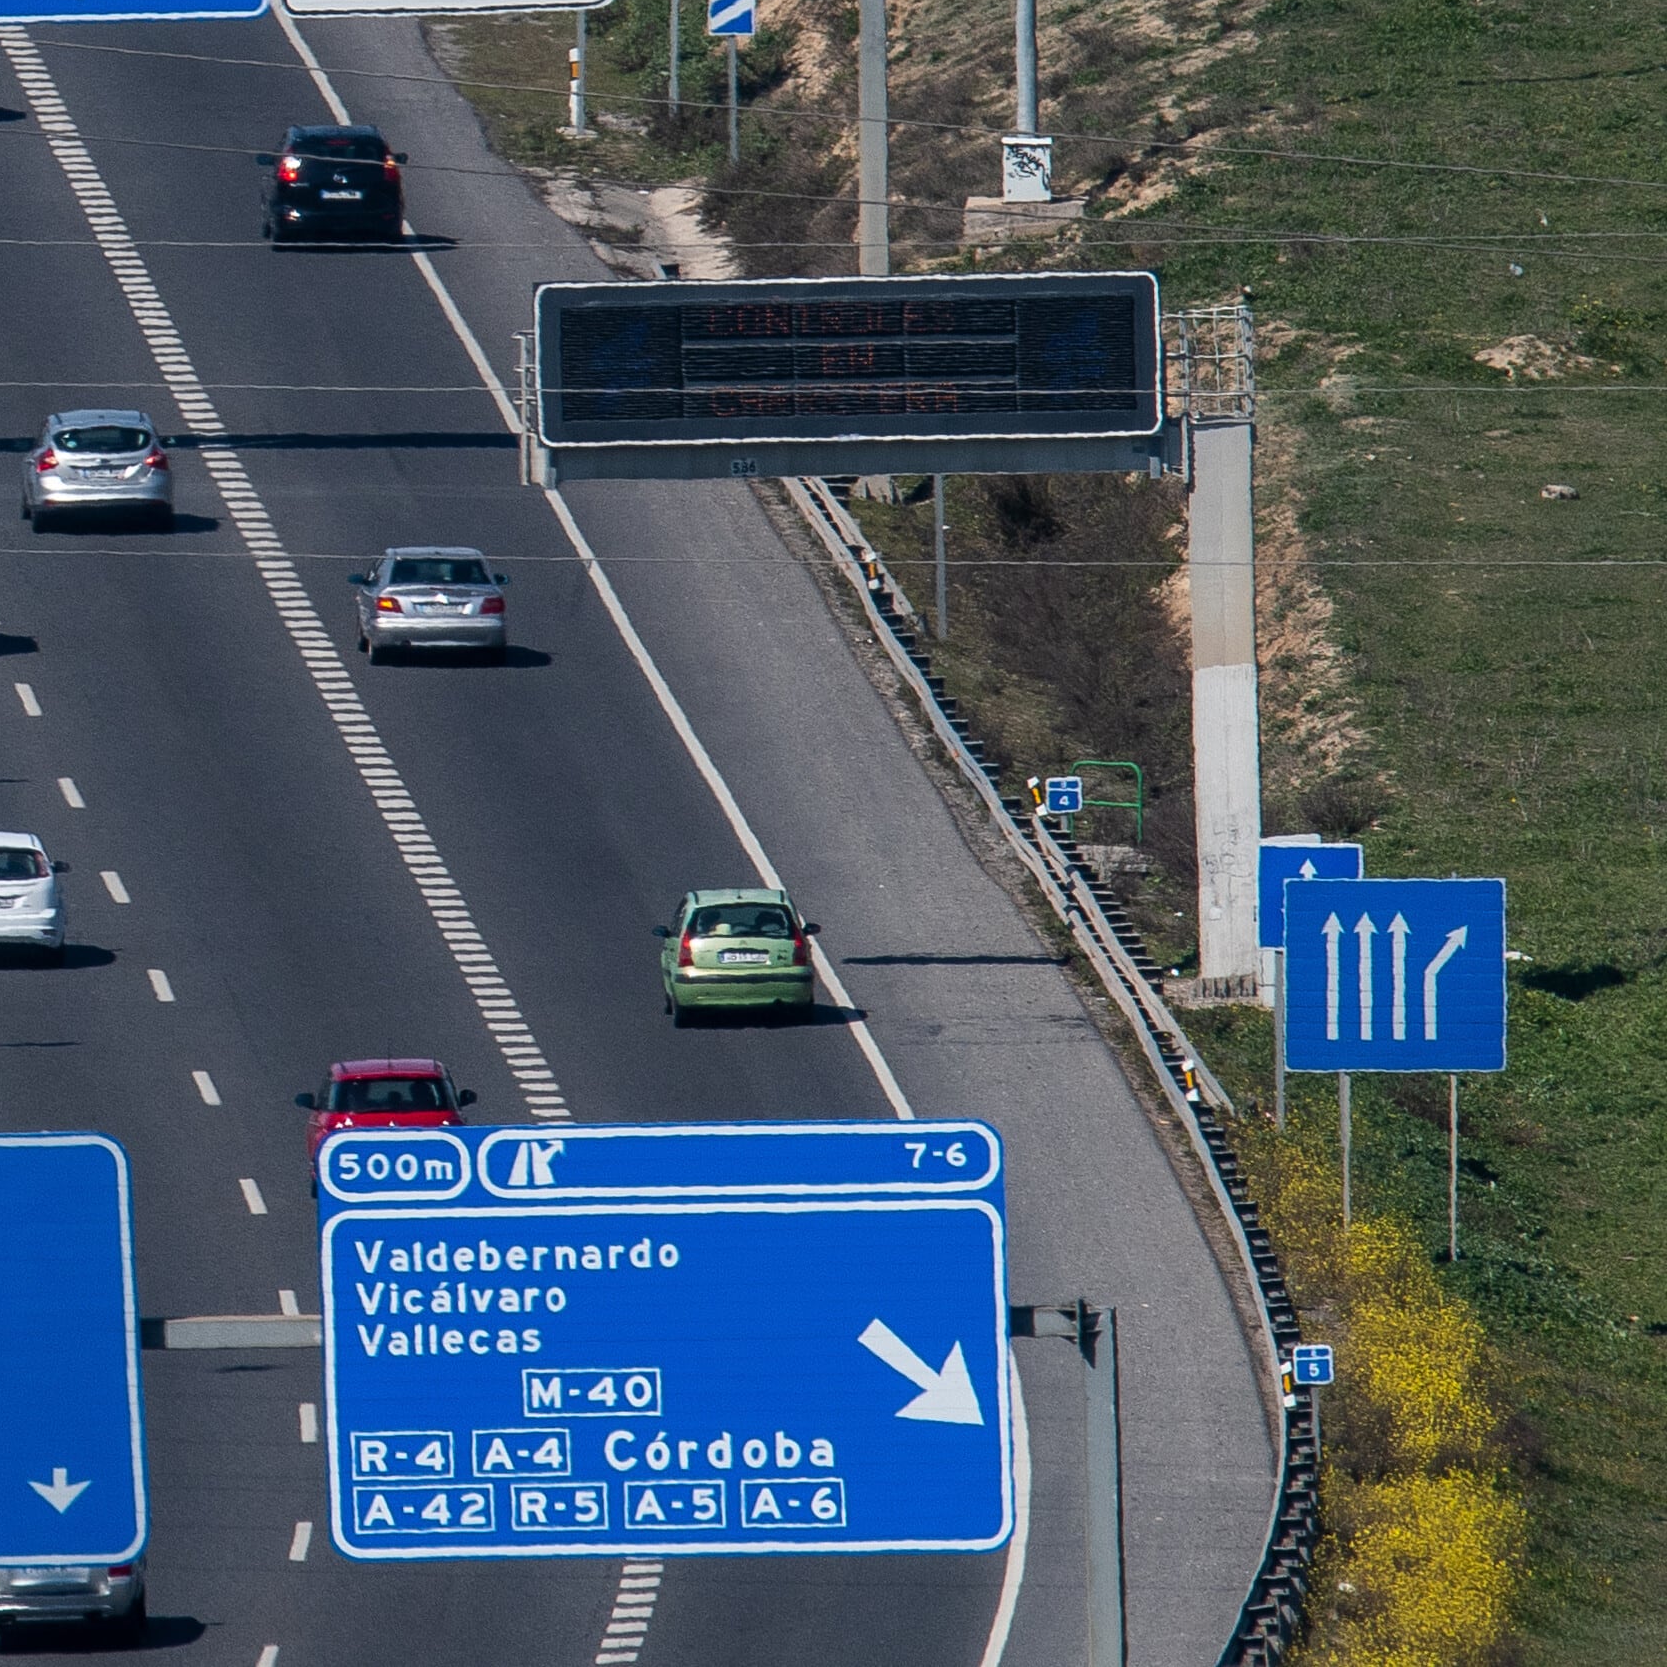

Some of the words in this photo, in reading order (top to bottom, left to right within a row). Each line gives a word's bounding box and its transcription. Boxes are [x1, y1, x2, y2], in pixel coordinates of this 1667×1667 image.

[1059, 795, 1069, 805] 4
[904, 1142, 968, 1168] 7-6
[355, 1239, 680, 1274] Valdebernardo
[355, 1281, 567, 1317] Vicálvaro
[356, 1323, 542, 1358] Vallecas
[1309, 1363, 1320, 1377] 5
[530, 1376, 653, 1410] M-40
[356, 1442, 446, 1472] R-4
[481, 1439, 564, 1469] A-4
[604, 1430, 835, 1471] Córdoba
[364, 1492, 487, 1526] A-42
[518, 1491, 600, 1522] R-5
[634, 1489, 719, 1521] A-5
[750, 1487, 837, 1520] A-6
